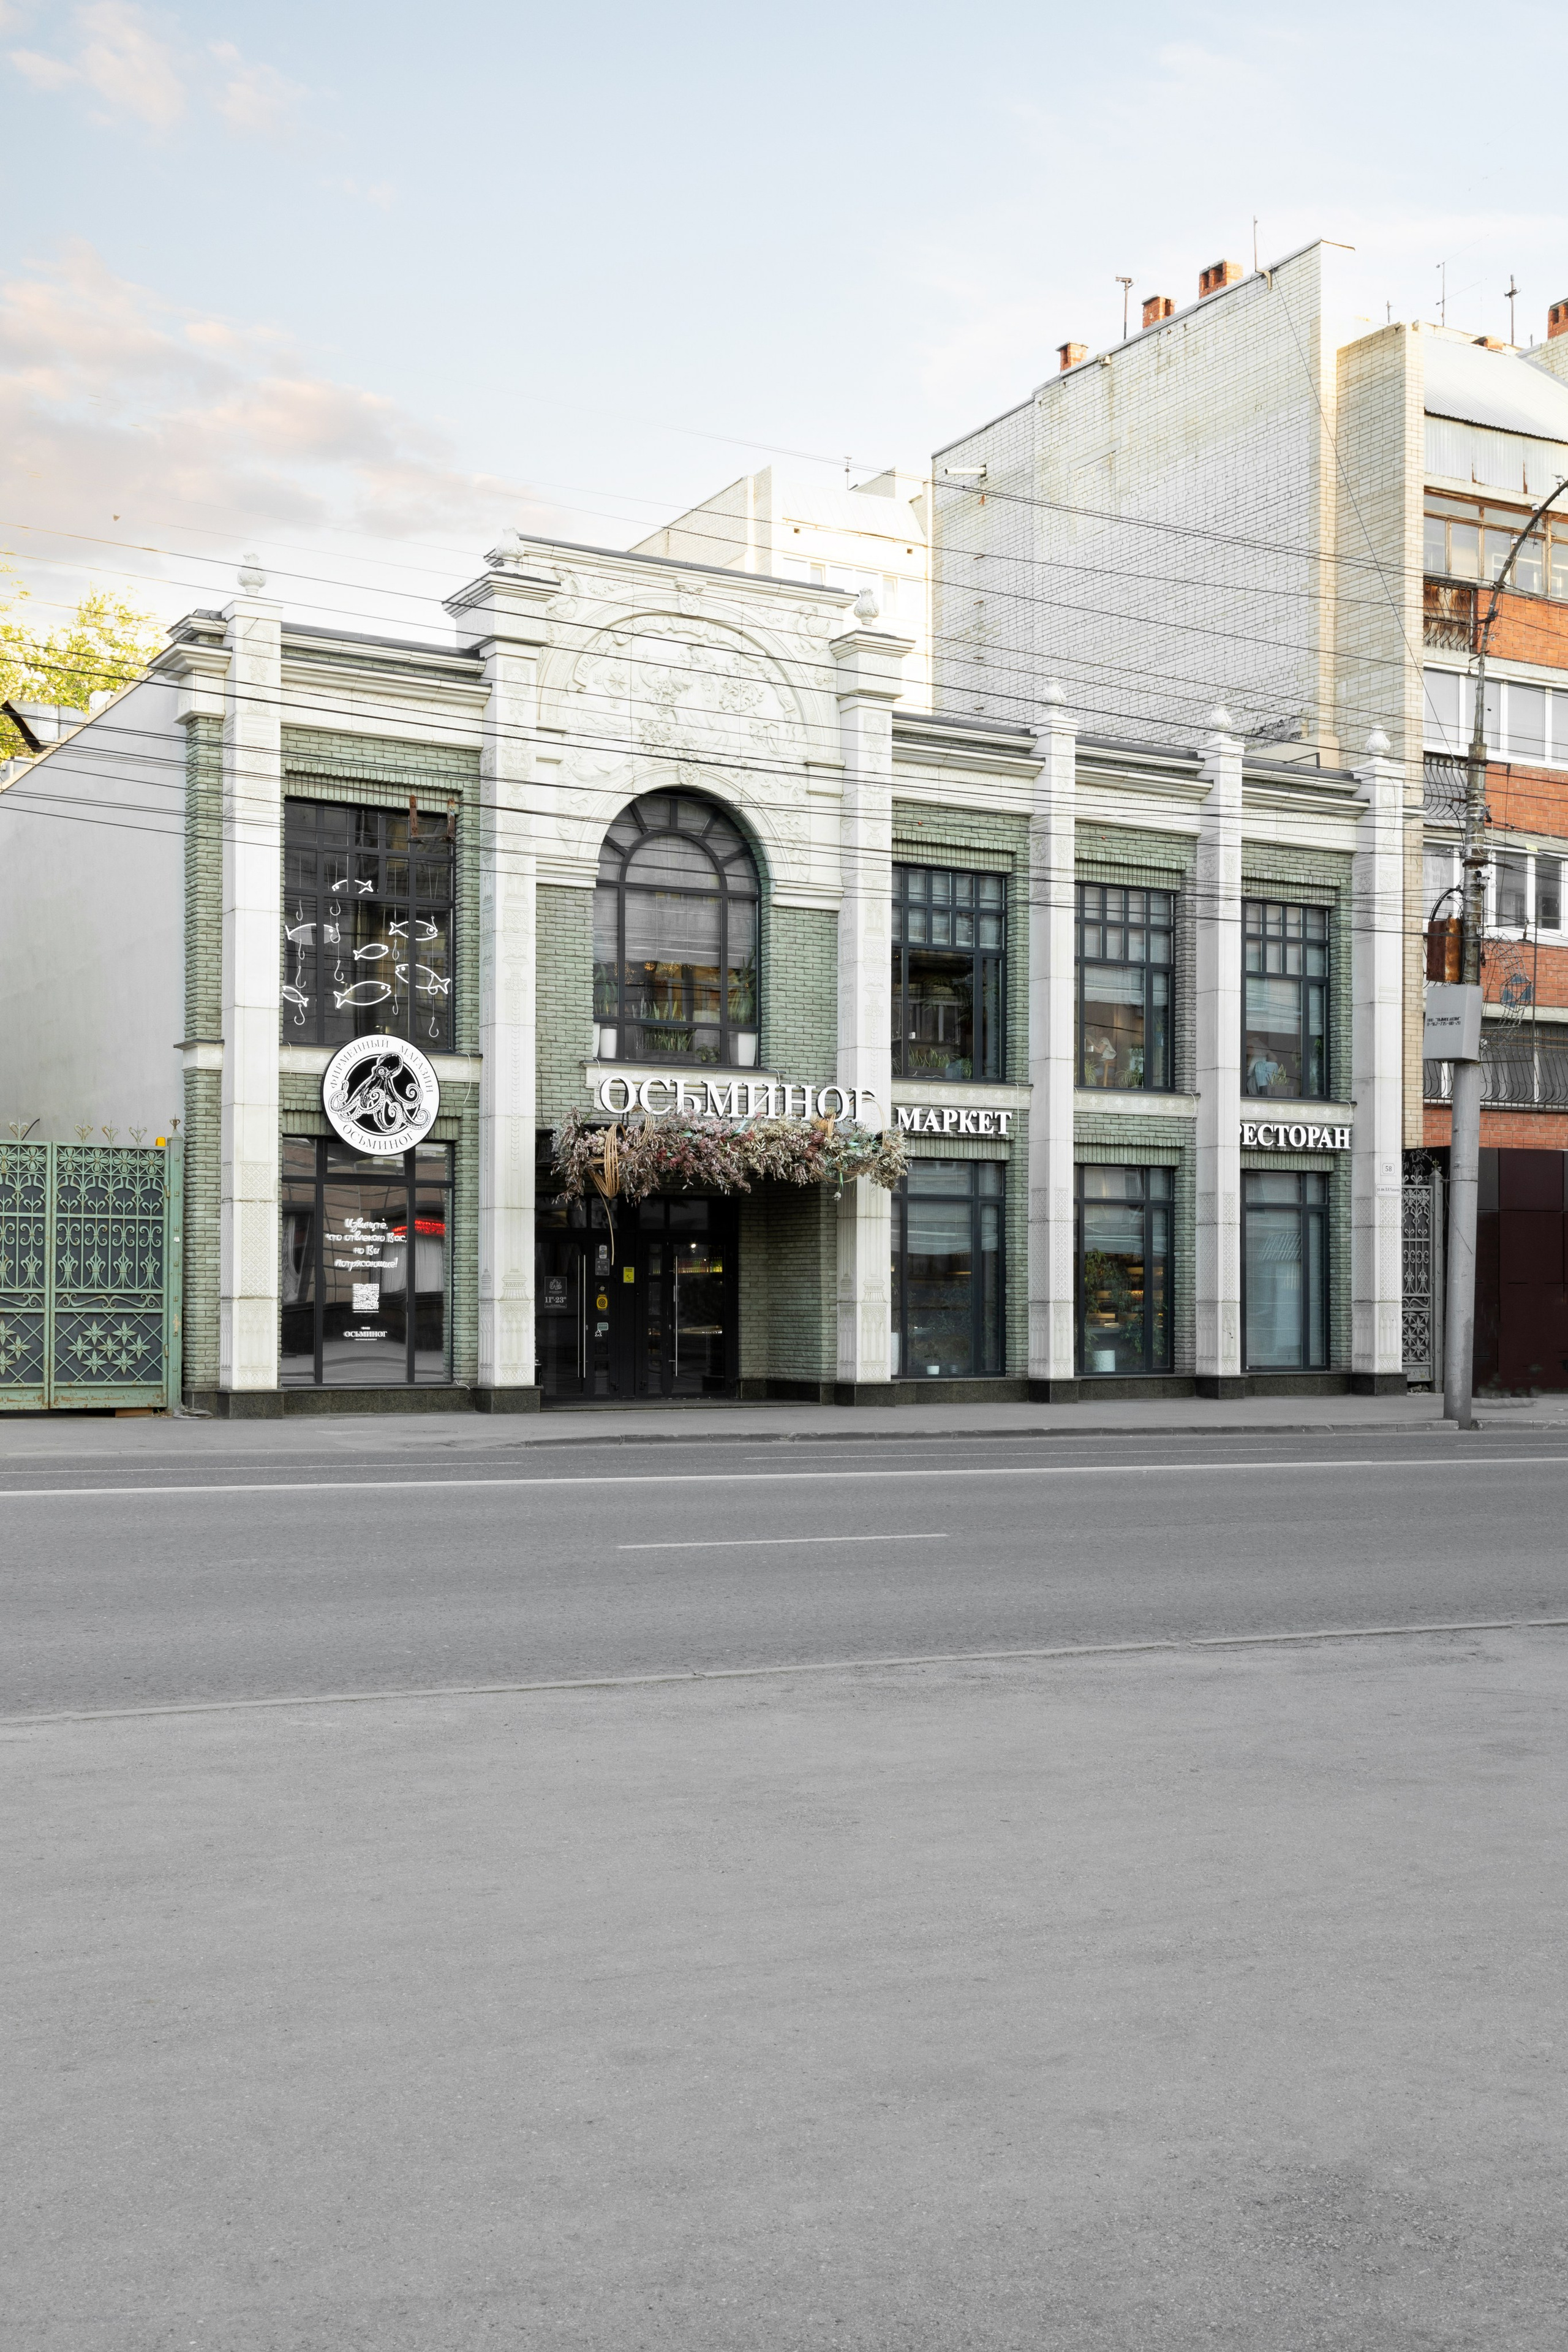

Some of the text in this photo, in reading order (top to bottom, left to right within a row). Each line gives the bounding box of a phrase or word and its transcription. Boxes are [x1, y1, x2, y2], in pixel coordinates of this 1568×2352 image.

[330, 1038, 434, 1093] ФИРМЕННЫЙ МАГАЗИН
[600, 1076, 875, 1122] ОСЬМИНОГ
[896, 1107, 1012, 1134] МАРКЕТ
[342, 1125, 414, 1150] ОСЬМИНОГ
[1240, 1123, 1351, 1149] ЕСТОРАН
[325, 1231, 407, 1243] что отвлекаю Вас,
[366, 1245, 380, 1255] Вы
